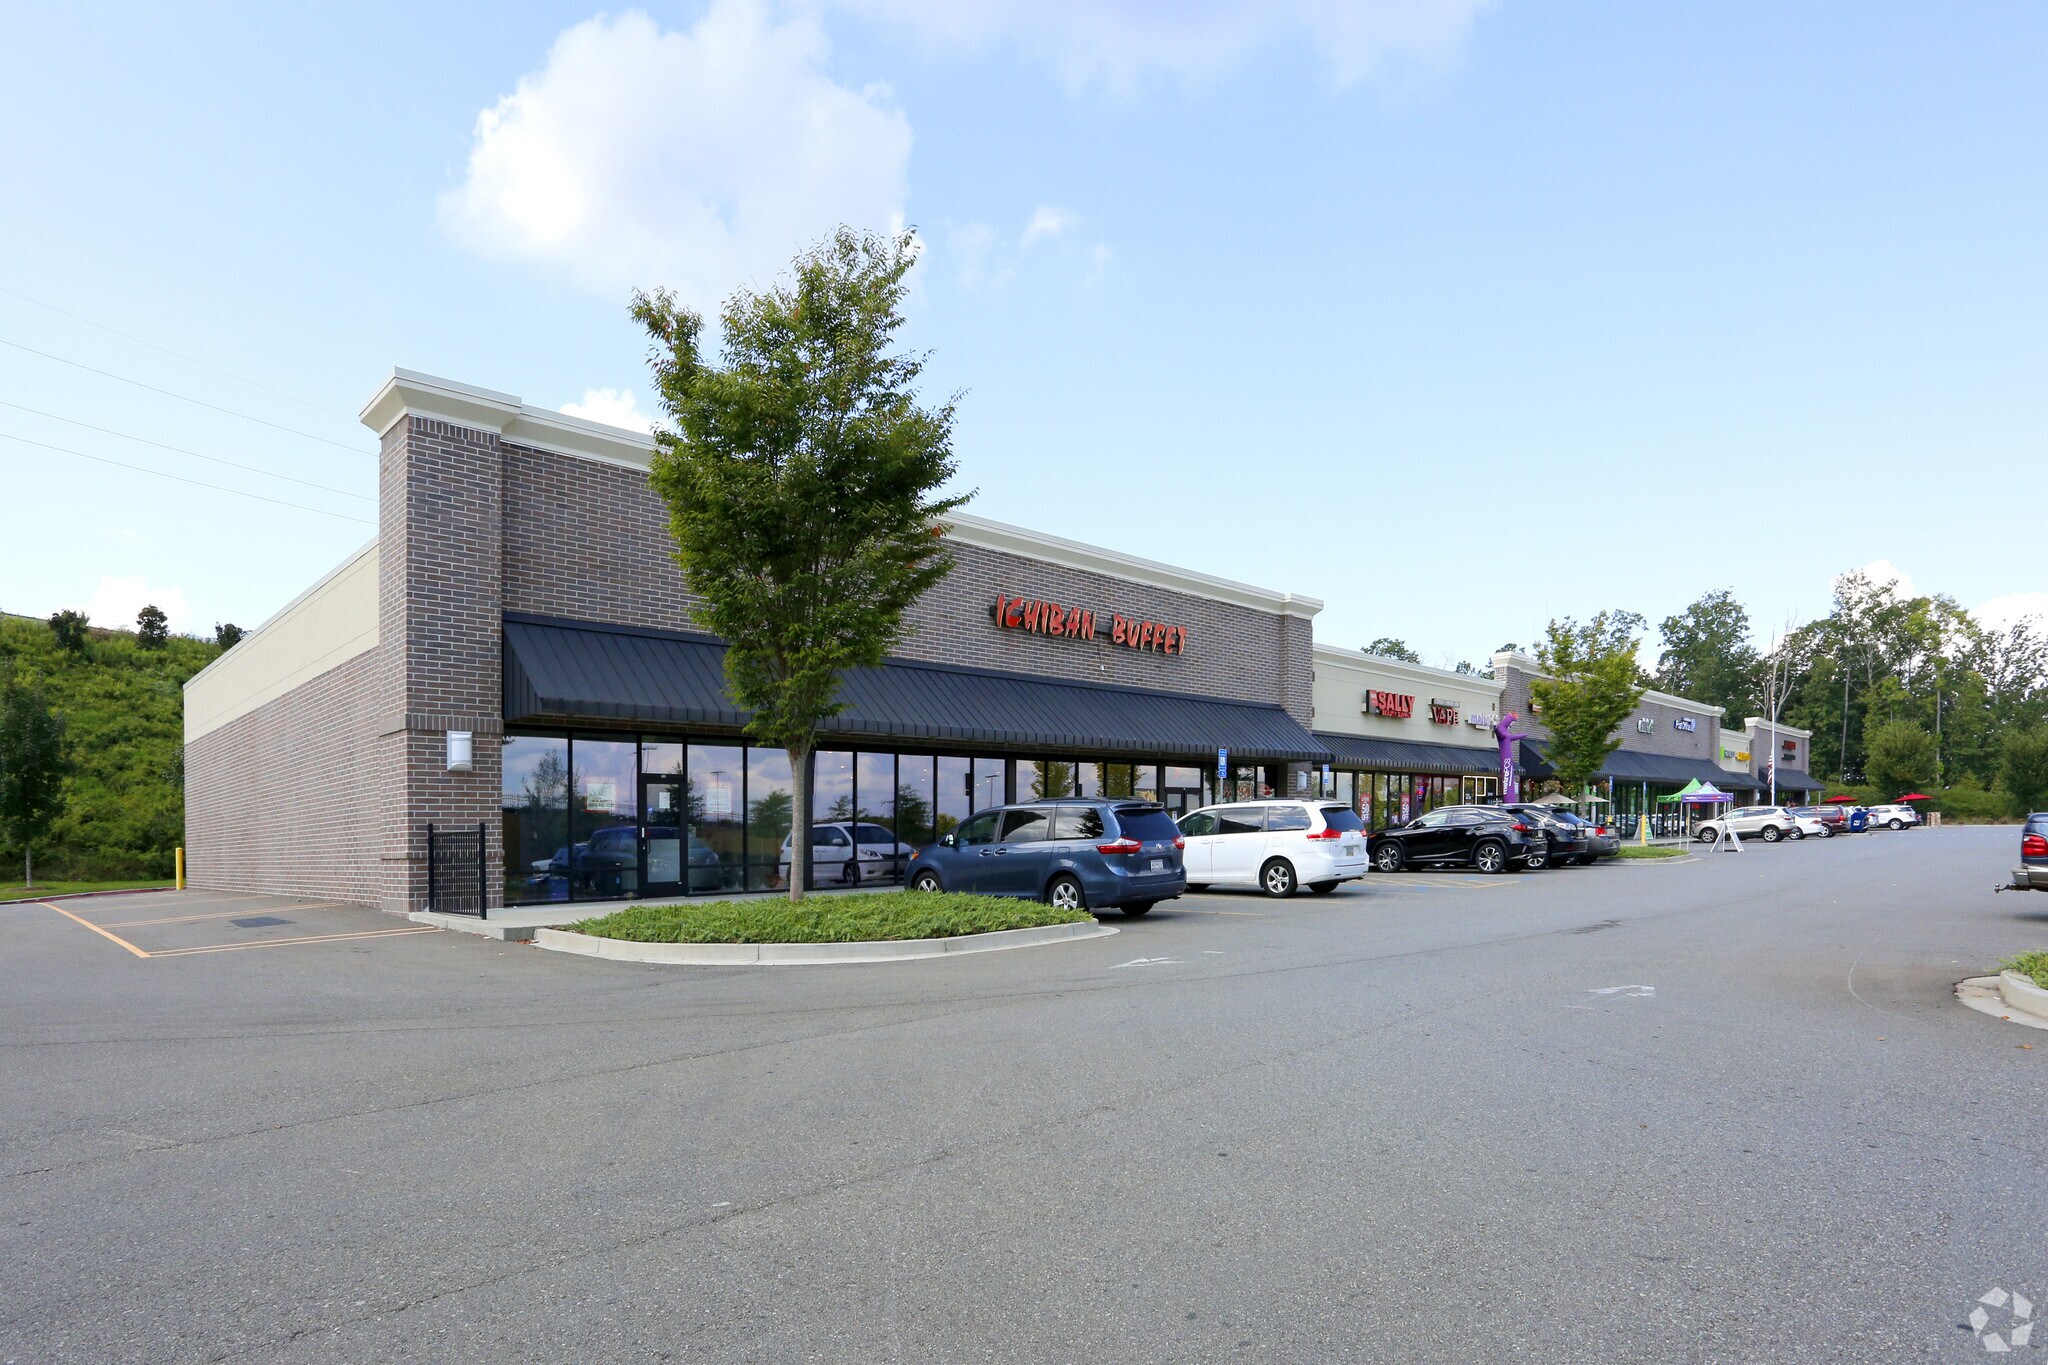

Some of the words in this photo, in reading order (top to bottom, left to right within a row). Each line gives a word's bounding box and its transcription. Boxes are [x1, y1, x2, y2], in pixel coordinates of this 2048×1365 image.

[995, 593, 1097, 640] ICHIBAN
[1111, 613, 1188, 656] BUFFET
[1377, 691, 1416, 713] SALLY
[1432, 706, 1459, 725] VAPE
[1503, 757, 1511, 795] metroPCS
